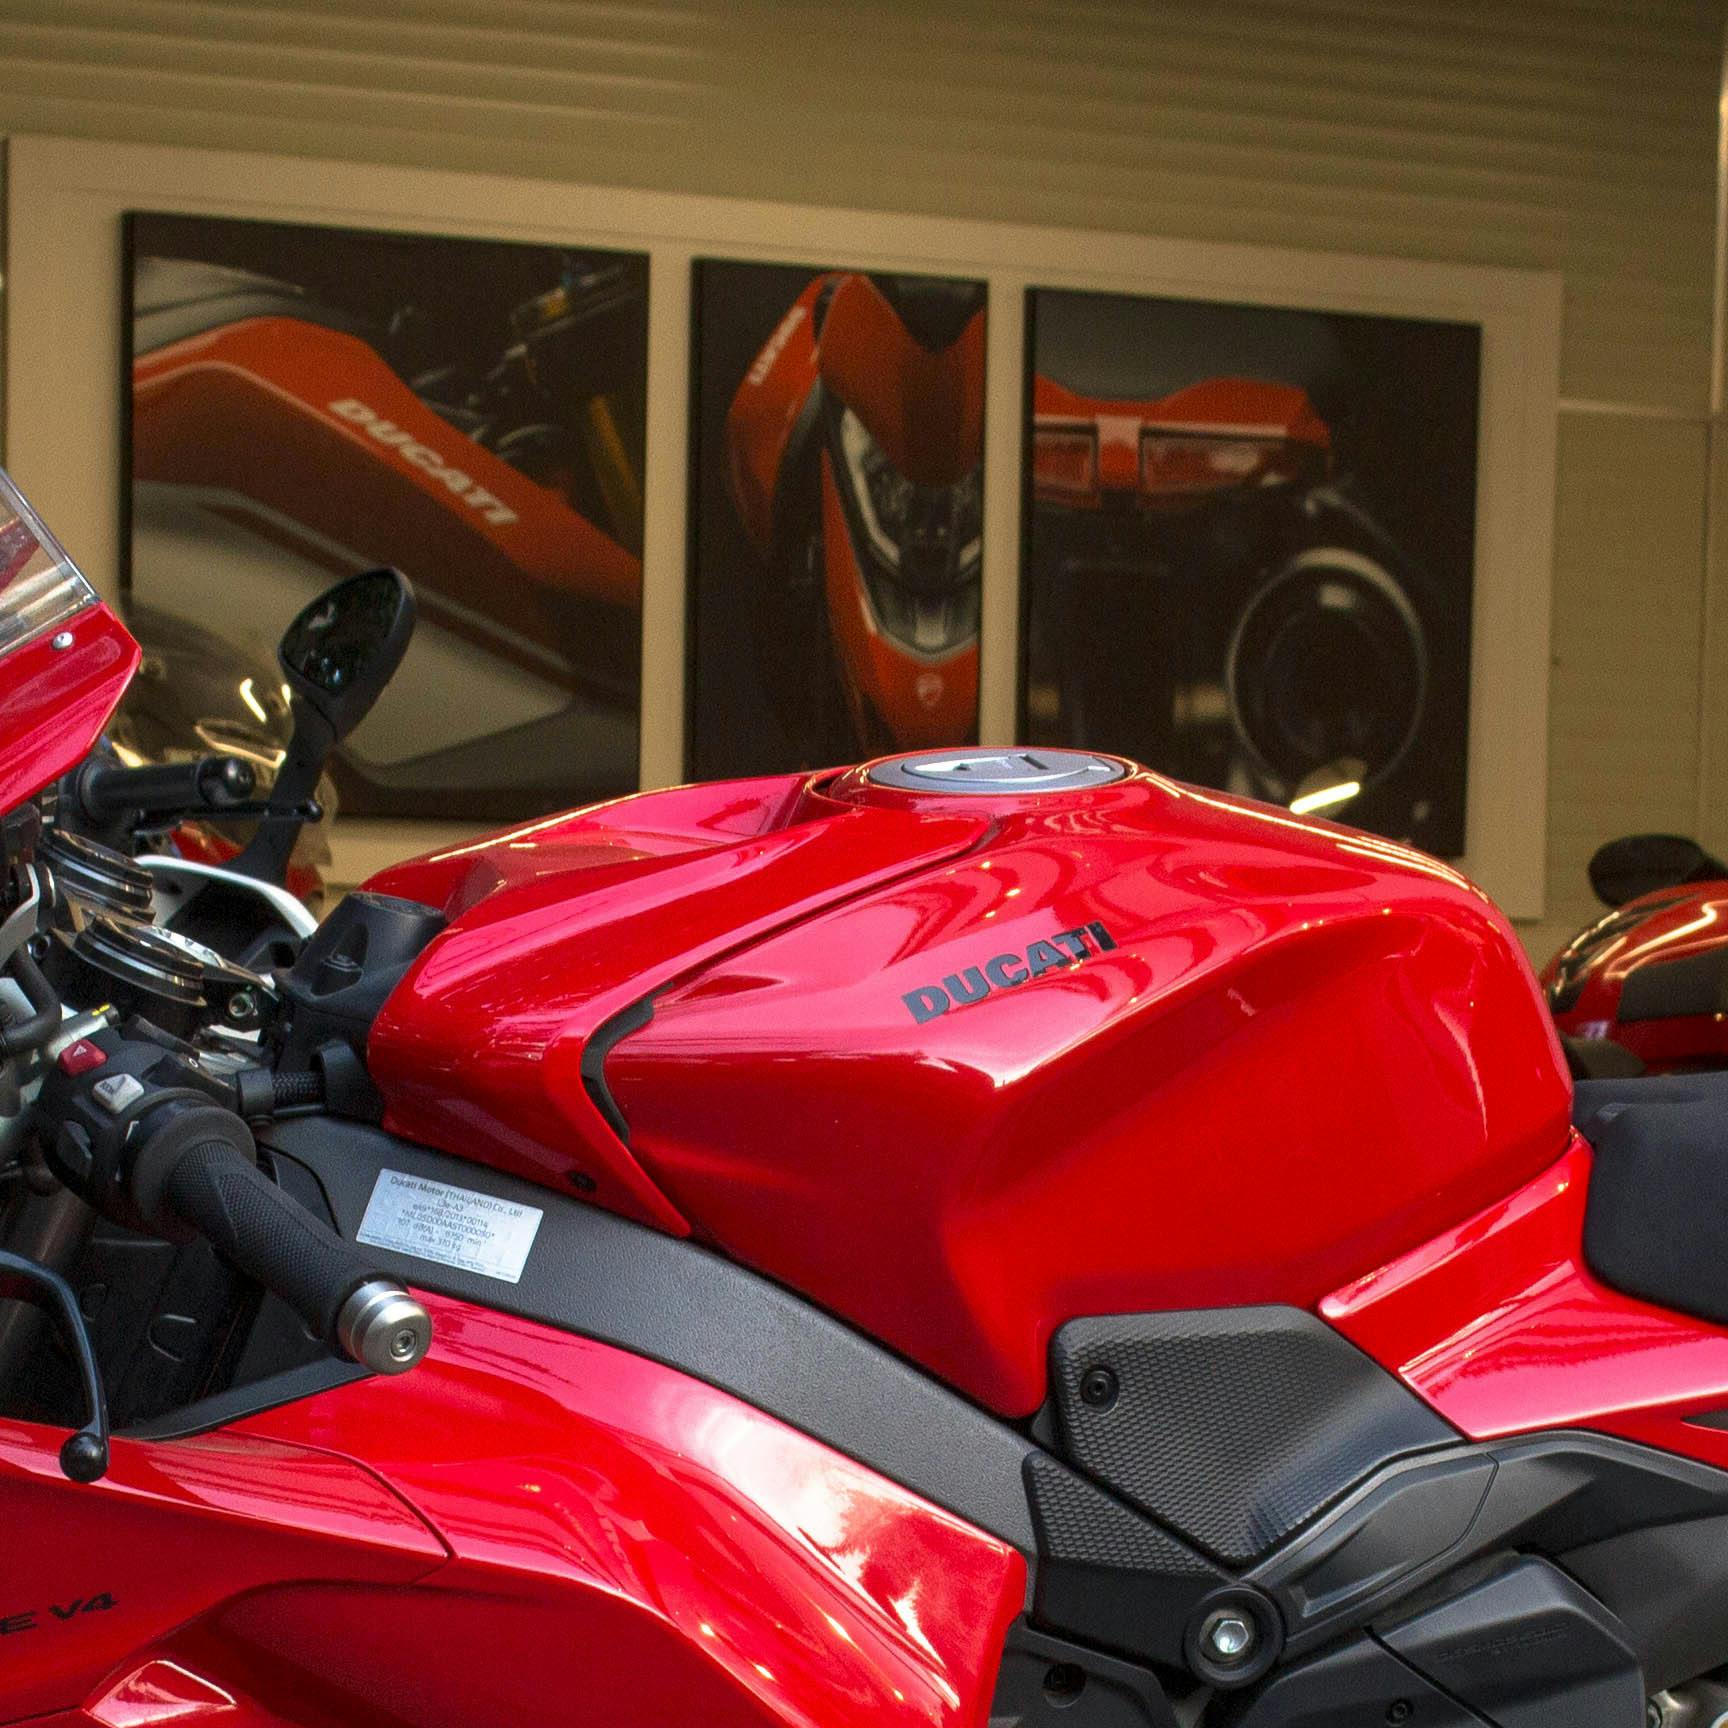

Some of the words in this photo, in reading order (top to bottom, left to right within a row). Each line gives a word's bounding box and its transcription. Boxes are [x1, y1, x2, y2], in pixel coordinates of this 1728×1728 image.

[328, 398, 519, 525] DUCATI
[901, 920, 1118, 1025] DUCATI
[390, 1176, 418, 1189] Ducati
[417, 1183, 444, 1197] Motor
[49, 1592, 119, 1621] V4
